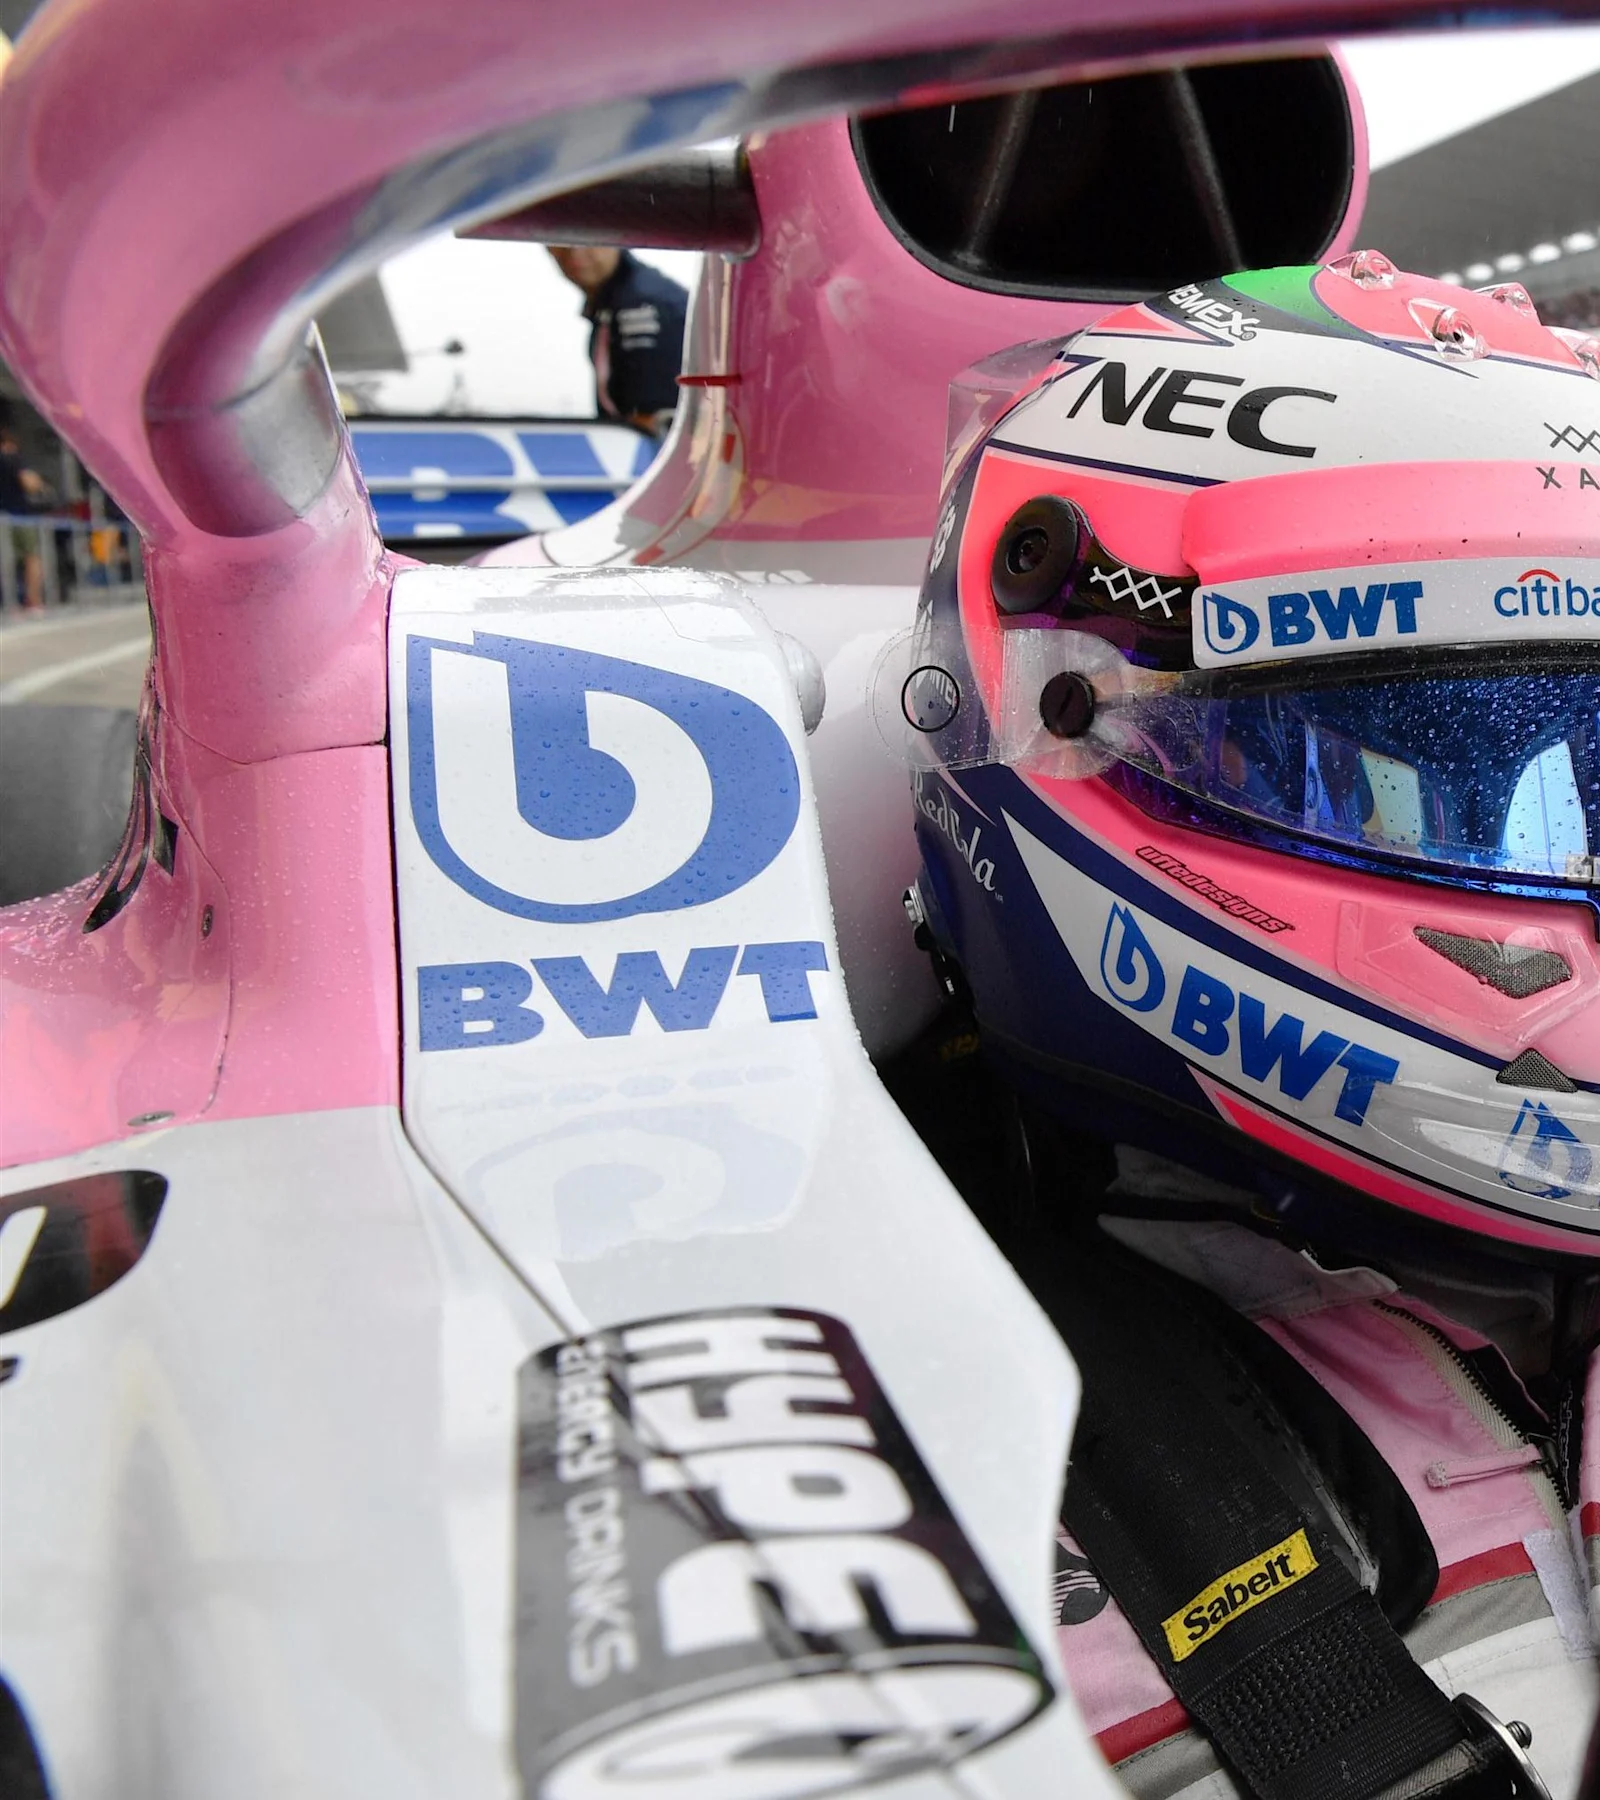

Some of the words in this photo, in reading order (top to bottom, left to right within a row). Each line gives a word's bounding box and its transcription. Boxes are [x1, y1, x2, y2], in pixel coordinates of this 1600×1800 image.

[1067, 361, 1338, 458] NEC
[1268, 581, 1424, 647] BWT
[1135, 845, 1290, 934] uffedesigns
[417, 940, 828, 1052] BWT
[1173, 965, 1399, 1127] BWT
[624, 1317, 978, 1657] HYPE
[563, 1487, 639, 1689] DRINKS
[1185, 1552, 1295, 1643] Sabelt
